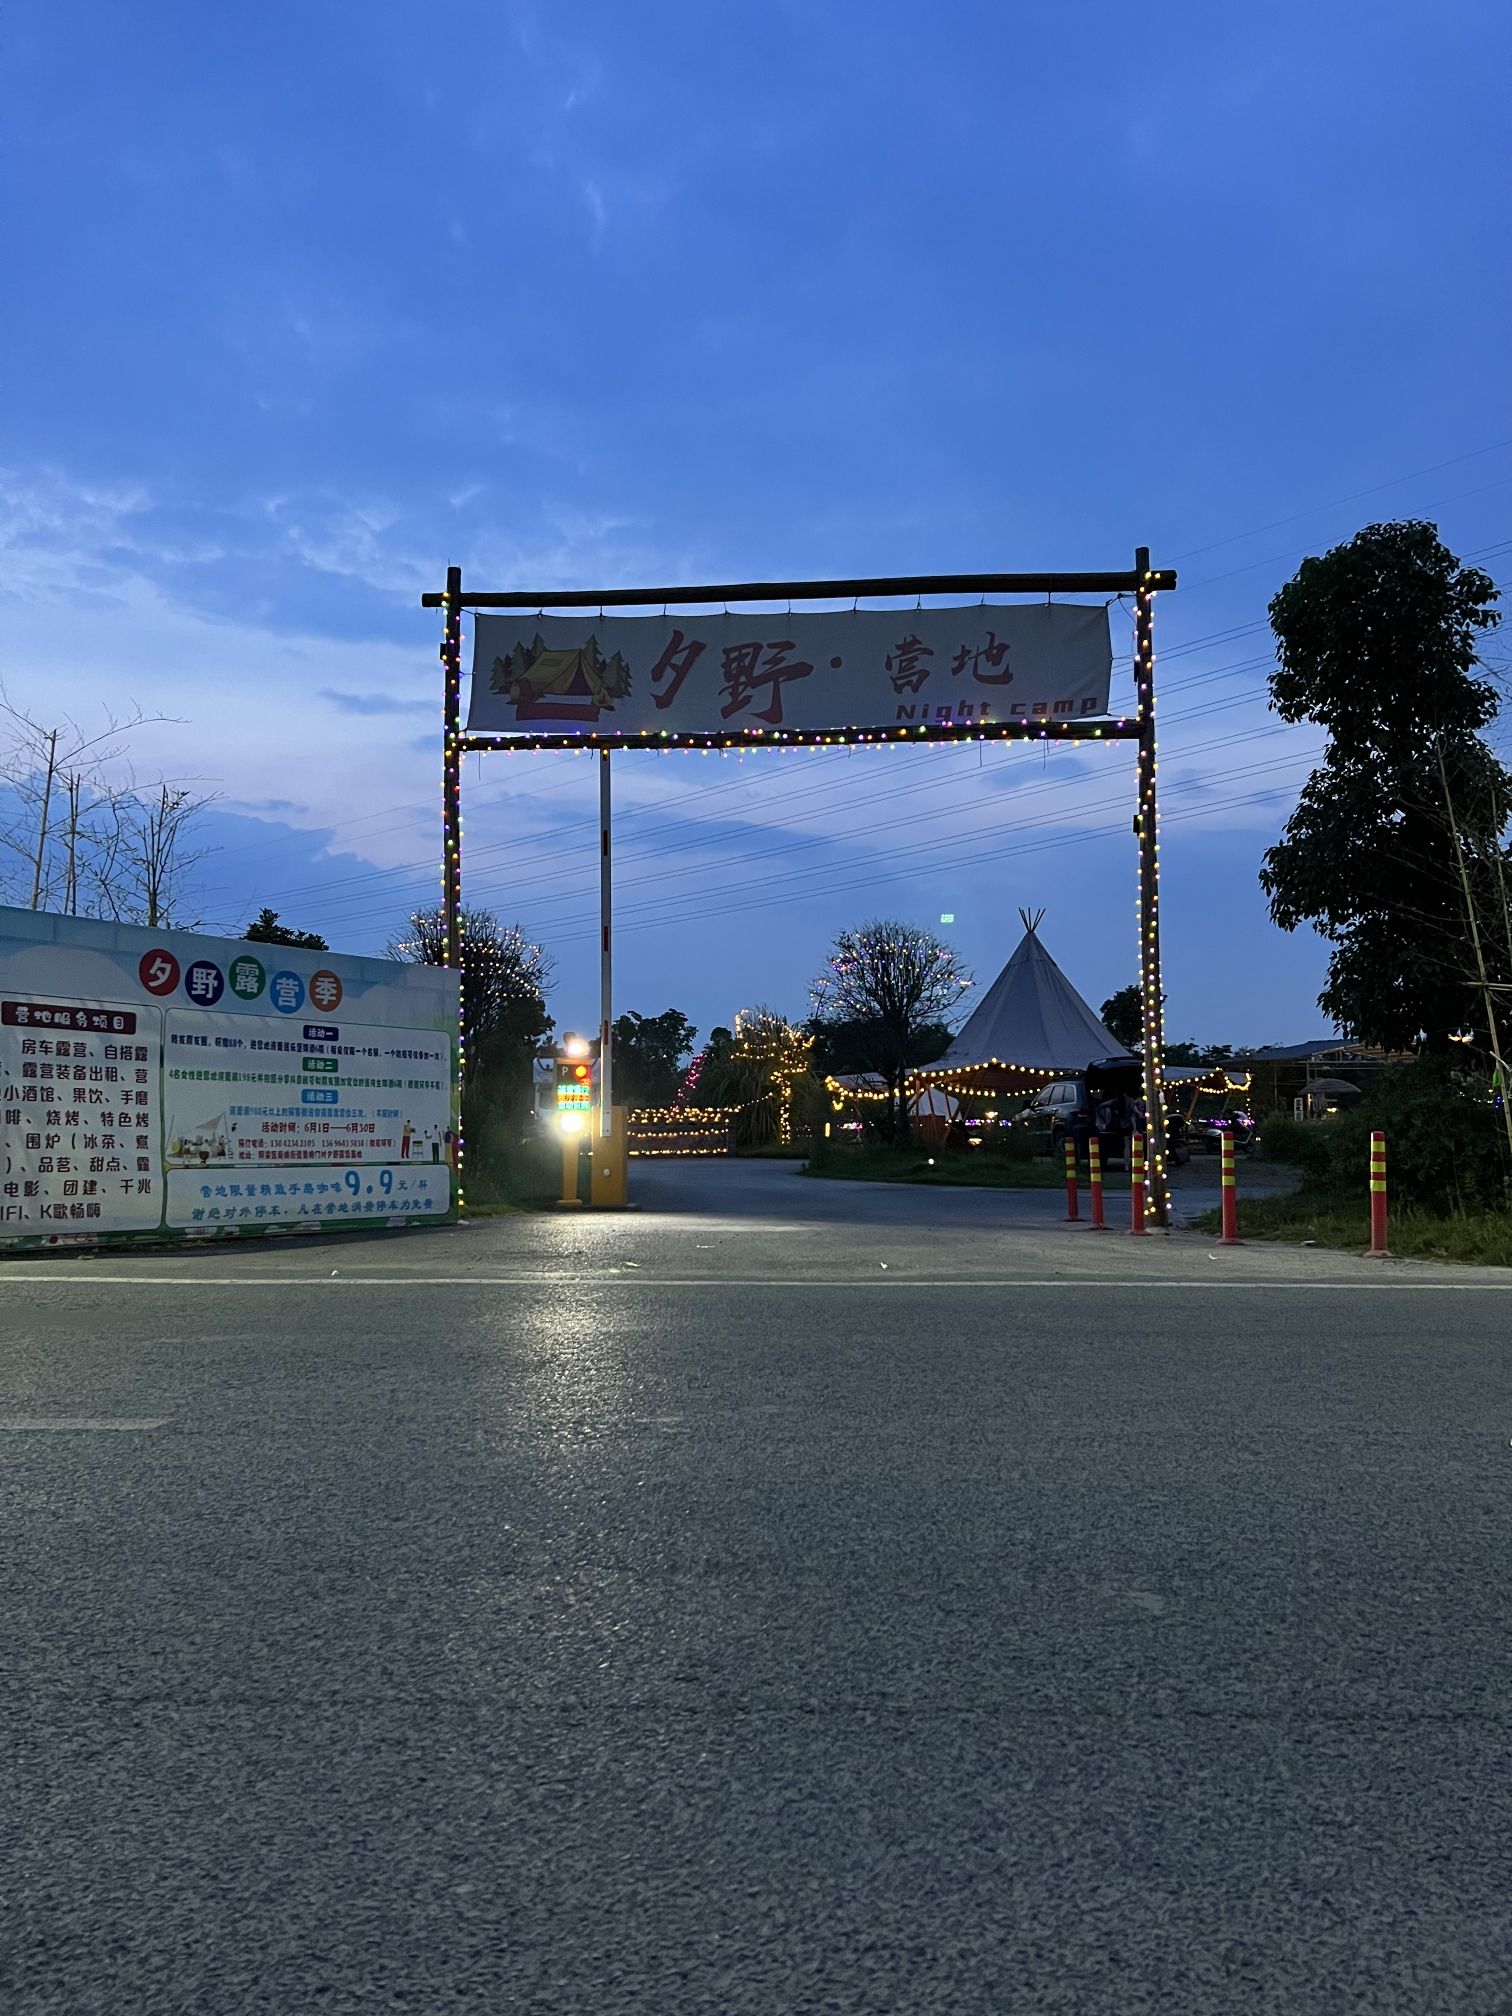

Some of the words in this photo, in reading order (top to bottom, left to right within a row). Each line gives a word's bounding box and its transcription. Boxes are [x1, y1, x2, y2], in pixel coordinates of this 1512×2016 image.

[896, 699, 991, 722] Night
[1010, 697, 1098, 717] camp
[148, 957, 338, 1006] 夕野露营季
[15, 1006, 124, 1029] 营地服务项目
[308, 1027, 334, 1039] 活动一
[308, 1059, 333, 1070] 活动二
[562, 1066, 568, 1076] P
[307, 1091, 334, 1102] 活动三
